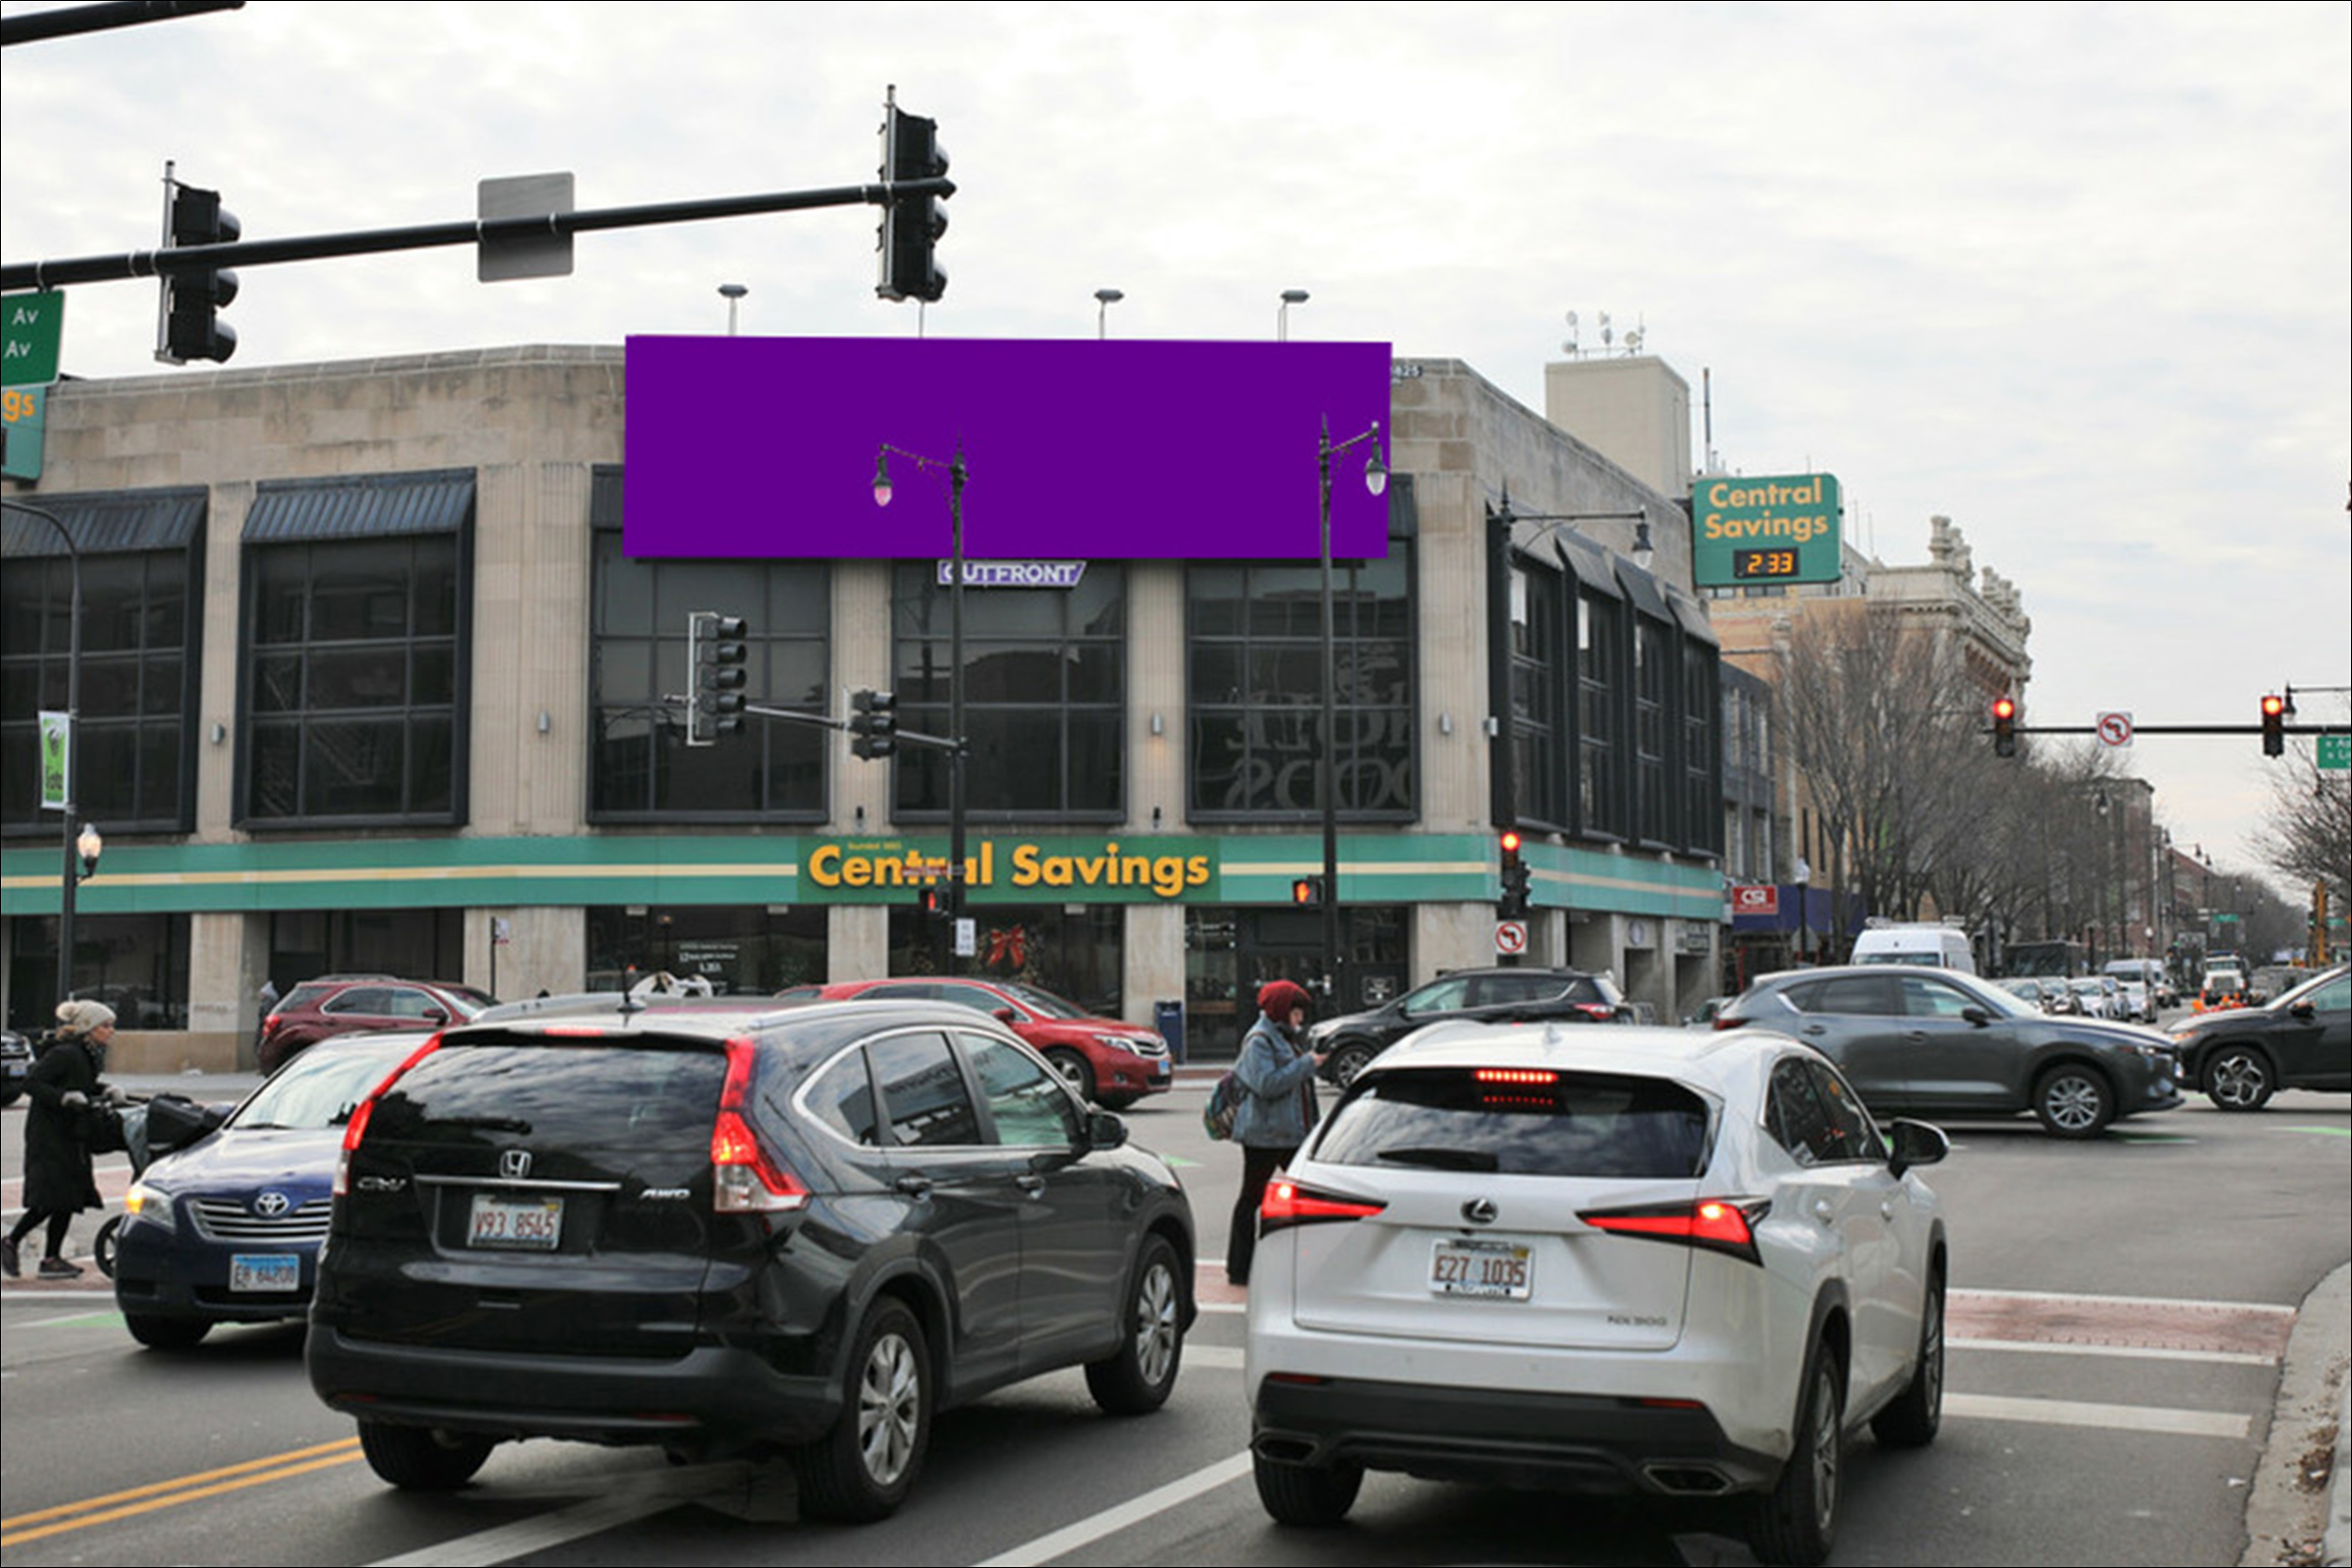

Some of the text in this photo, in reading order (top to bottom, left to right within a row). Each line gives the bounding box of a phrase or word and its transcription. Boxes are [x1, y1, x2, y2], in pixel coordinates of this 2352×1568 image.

[12, 307, 38, 325] Av
[4, 339, 30, 359] Av
[3, 389, 35, 422] gs
[1709, 476, 1822, 508] Central
[1705, 510, 1829, 542] Savings
[809, 842, 1210, 898] Central Savings
[1481, 1258, 1527, 1288] 1035
